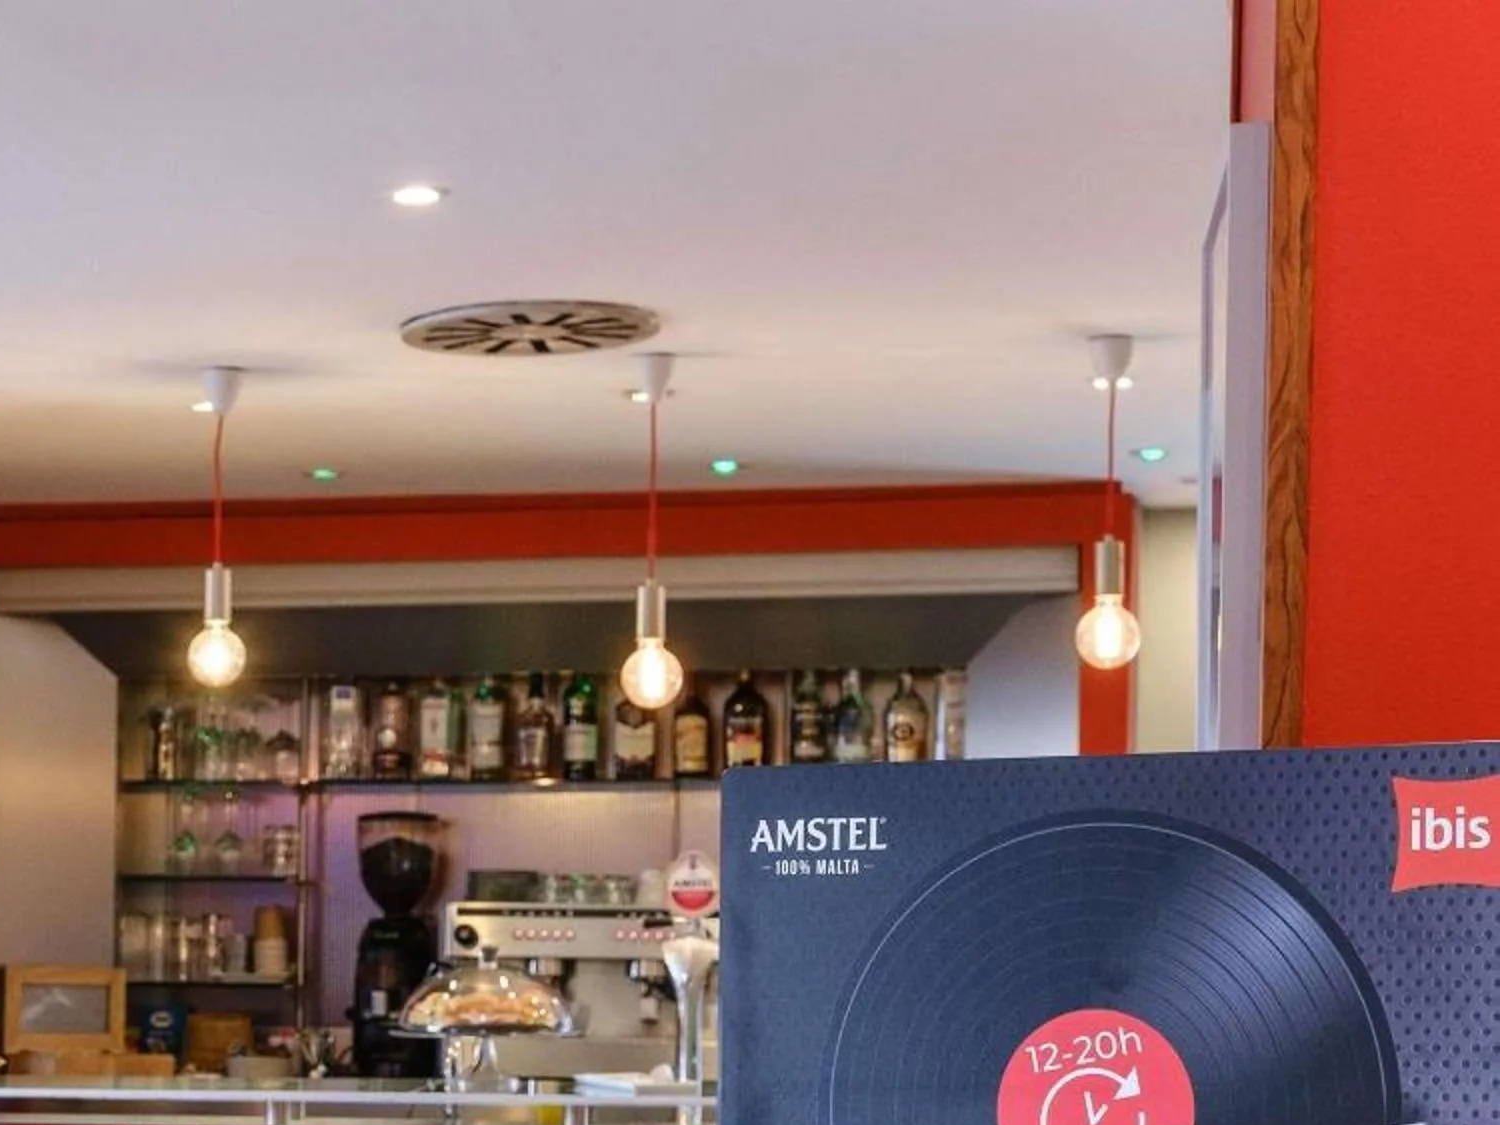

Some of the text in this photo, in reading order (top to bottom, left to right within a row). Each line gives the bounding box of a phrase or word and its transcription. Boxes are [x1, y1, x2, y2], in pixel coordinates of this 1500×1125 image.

[749, 817, 888, 853] AMSTEL
[1411, 805, 1491, 851] ibis
[775, 859, 860, 876] 100% MALTA
[1025, 1026, 1143, 1073] 12-20h
